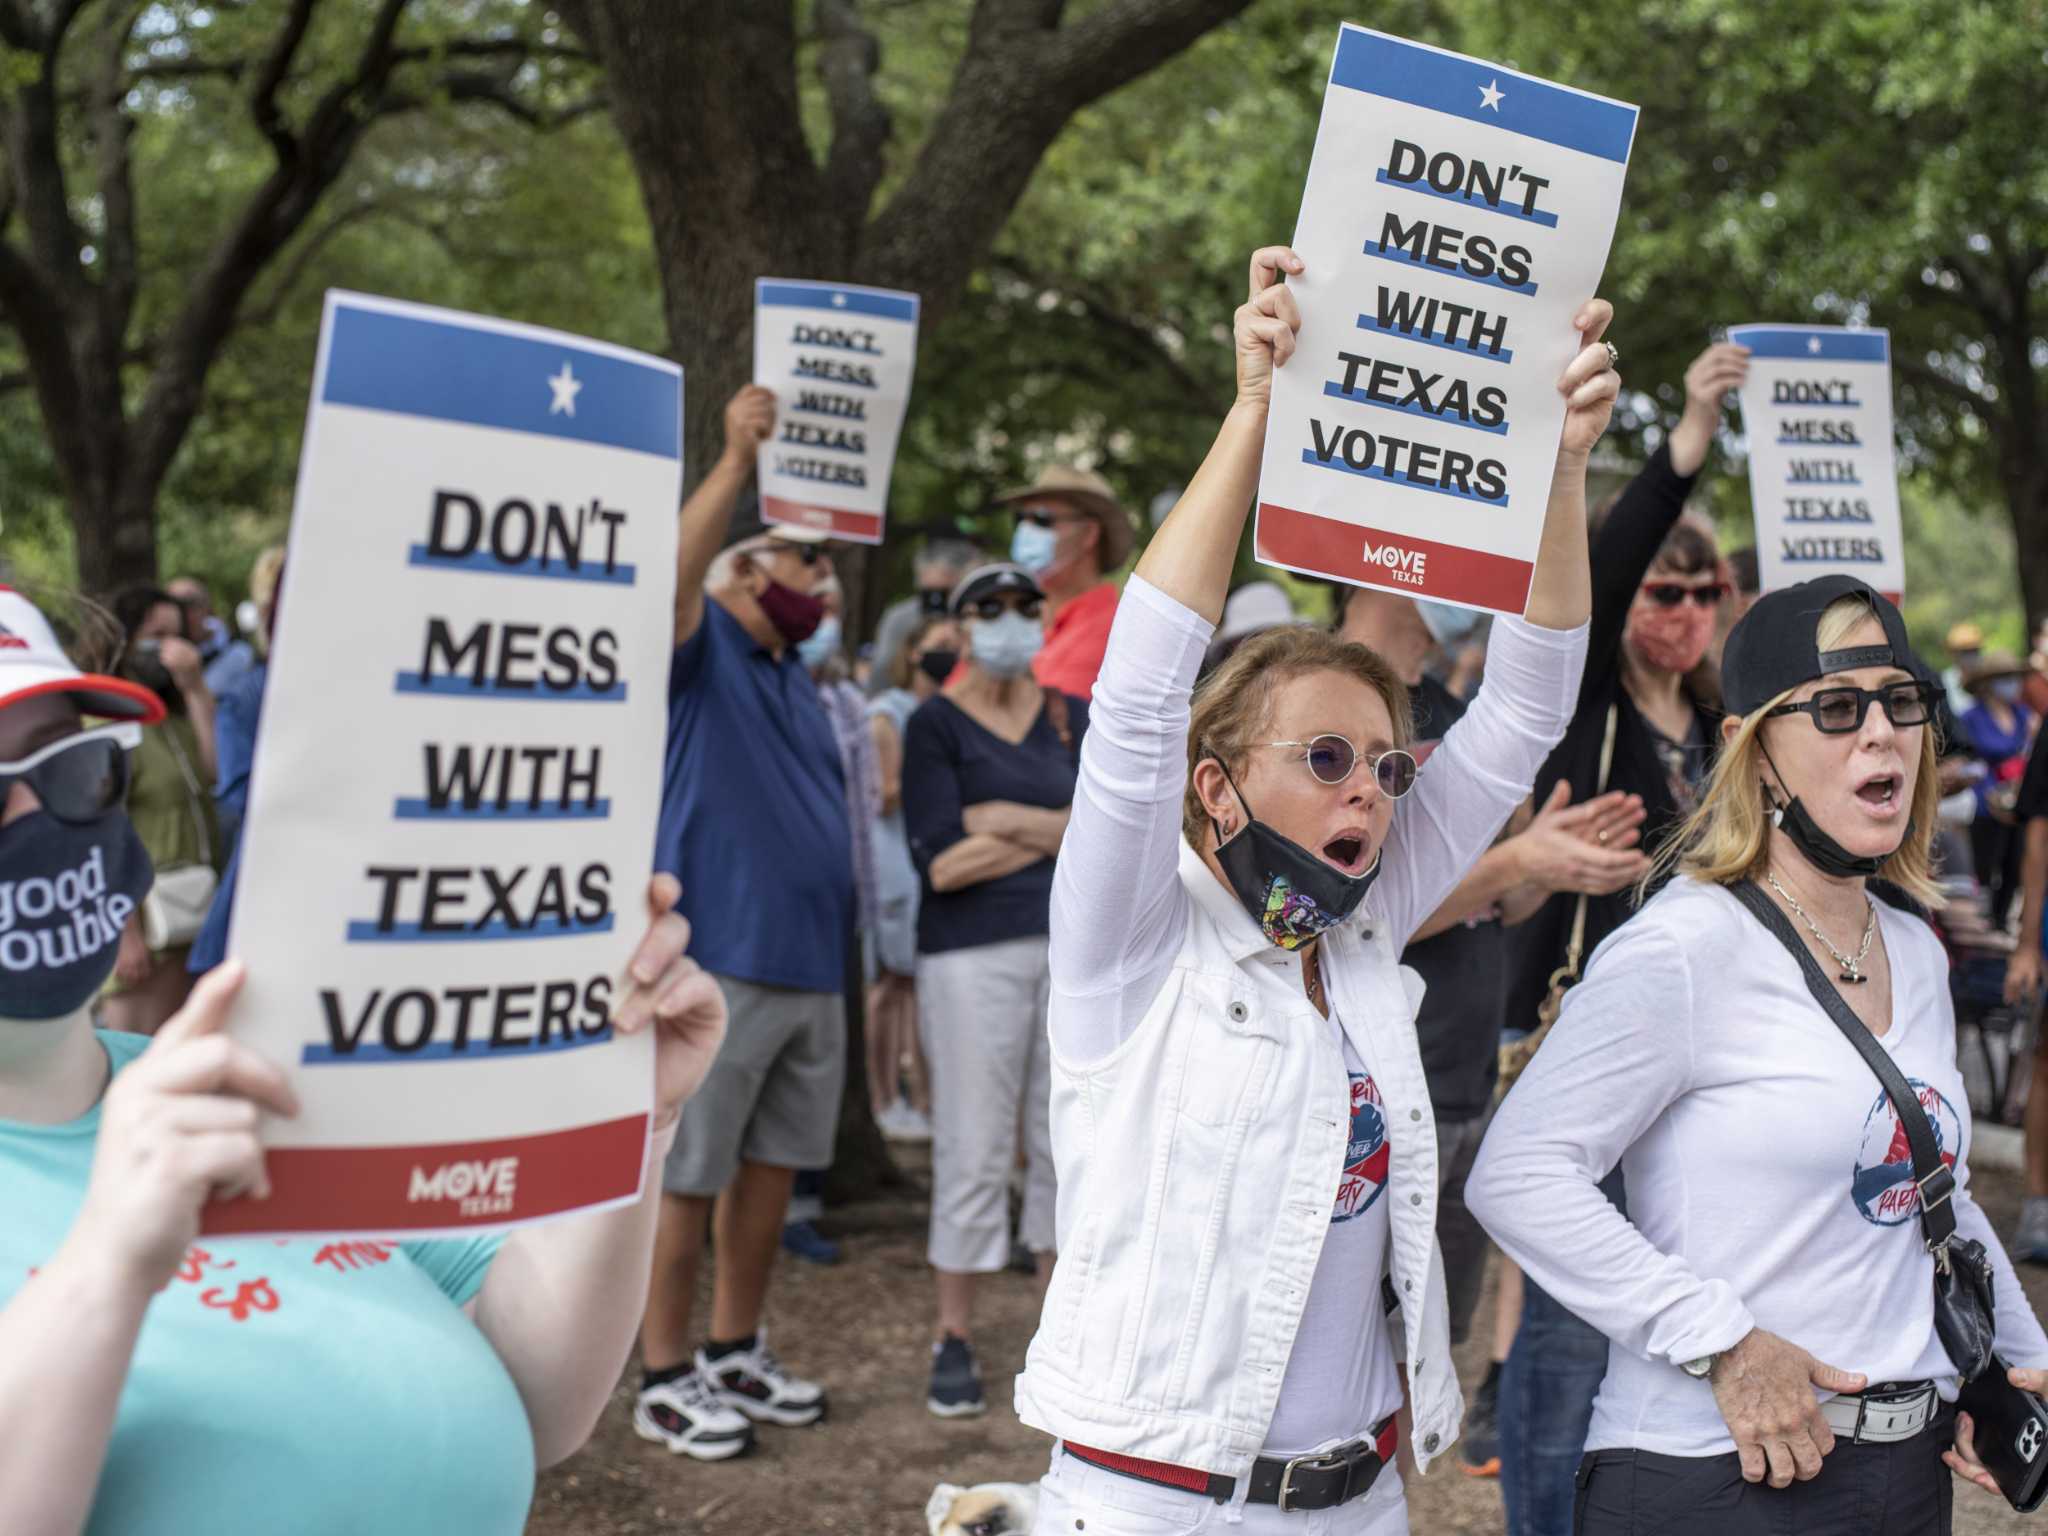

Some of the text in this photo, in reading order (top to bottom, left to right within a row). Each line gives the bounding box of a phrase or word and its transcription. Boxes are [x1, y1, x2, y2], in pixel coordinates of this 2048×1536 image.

[1387, 139, 1549, 216] DON'T
[1378, 212, 1532, 286] MESS
[793, 323, 876, 350] DON'T
[1377, 285, 1508, 354] WITH
[798, 357, 875, 387] MESS
[1338, 351, 1507, 427] TEXAS
[1773, 379, 1853, 404] DON'T
[800, 390, 866, 419] WITH
[784, 421, 866, 452] TEXAS
[1780, 418, 1858, 444] MESS
[775, 454, 866, 488] VOTERS
[1310, 418, 1506, 499] VOTERS
[1789, 459, 1857, 482] WITH
[1785, 498, 1871, 521] TEXAS
[426, 488, 627, 576] DON'T
[1781, 537, 1883, 561] VOTERS
[1363, 540, 1426, 574] MOVE
[1392, 569, 1424, 586] TEXAS
[420, 615, 620, 693] MESS
[423, 744, 602, 812] WITH
[366, 862, 612, 934] TEXAS
[0, 893, 134, 971] ouble
[319, 974, 612, 1055] VOTERS
[407, 1156, 519, 1202] MOVE
[1878, 1178, 1921, 1217] PART
